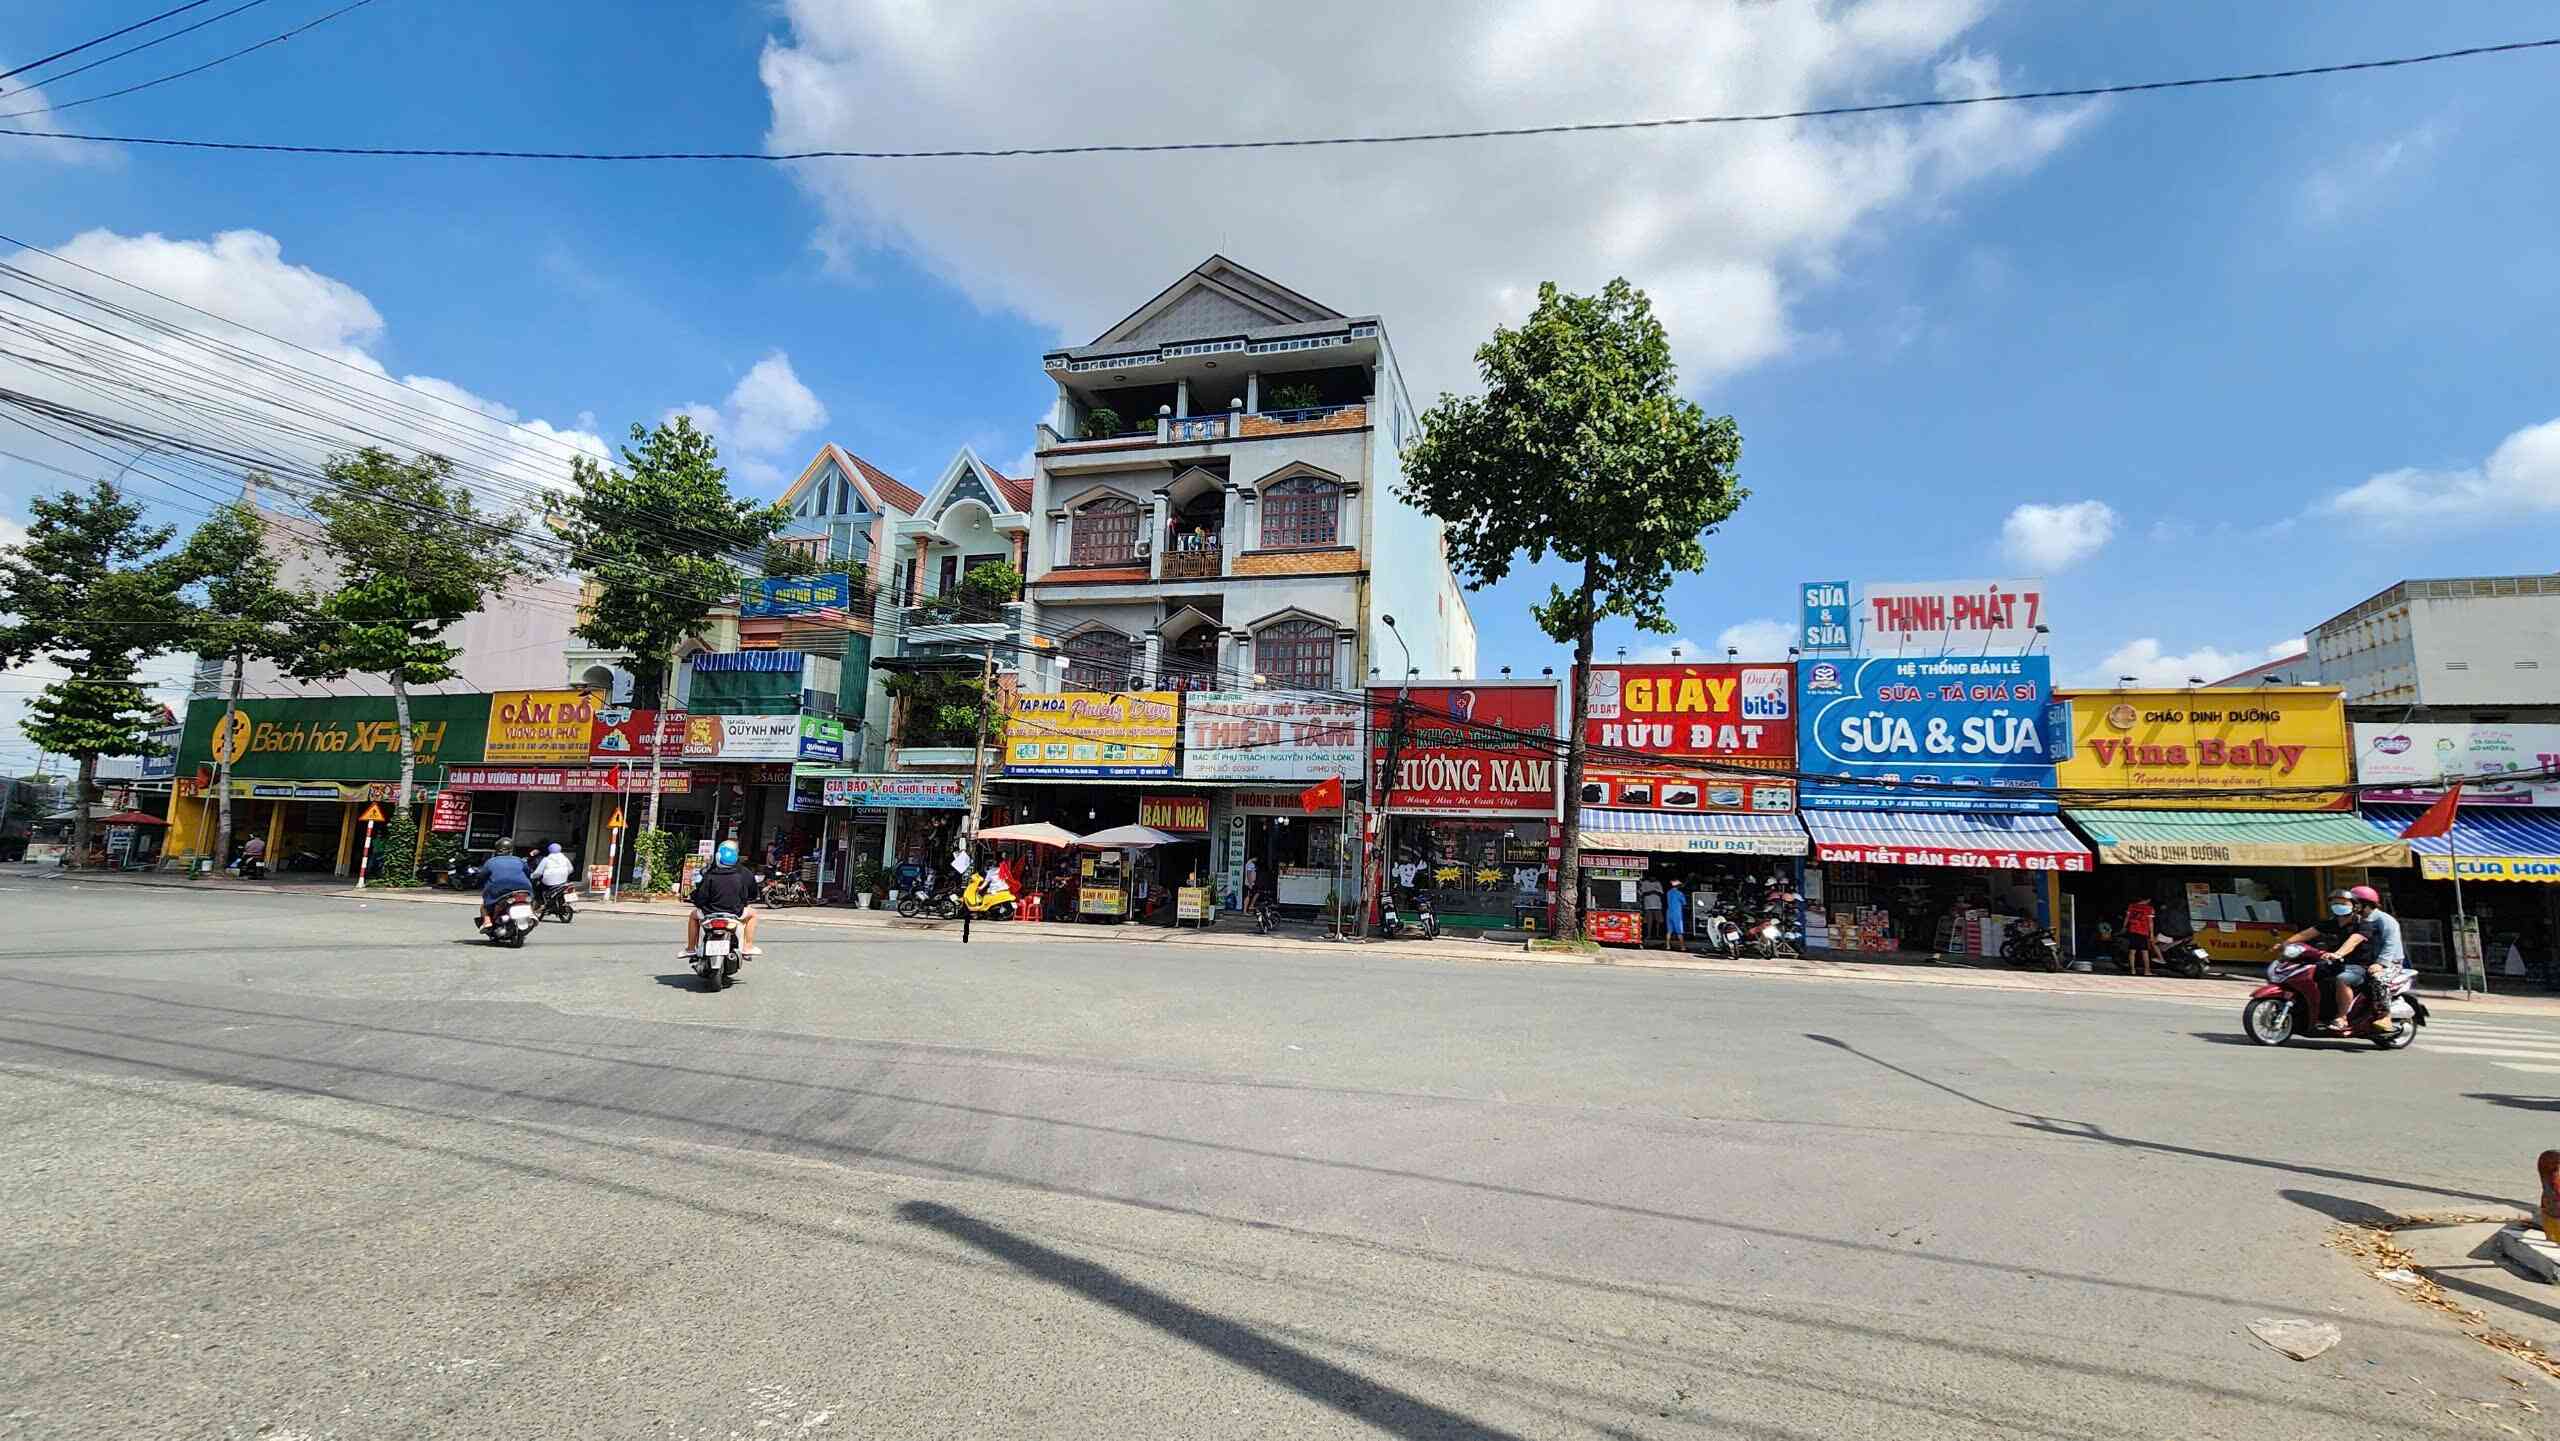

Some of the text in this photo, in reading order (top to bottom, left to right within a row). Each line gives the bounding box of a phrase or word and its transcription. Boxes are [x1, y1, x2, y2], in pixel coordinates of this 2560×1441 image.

[1807, 585, 1845, 607] SỮA
[1820, 609, 1833, 621] &
[1872, 584, 2040, 642] THỊNH PHÁT 7
[1807, 623, 1847, 645] SỮA
[1897, 662, 1917, 677] HỆ
[1921, 658, 1968, 675] THỐNG
[1970, 661, 2001, 675] BÁN
[1625, 668, 1737, 713] GIÀY
[1879, 681, 1920, 702] SỮA
[1940, 681, 1967, 701] TÃ
[1970, 680, 2008, 701] GIÁ
[501, 693, 592, 724] CẦM ĐỒ
[2145, 707, 2281, 723] CHÁO DINH DƯỠNG
[251, 720, 303, 752] Bách
[307, 720, 348, 752] hóa
[728, 722, 796, 735] QUỲNH NHƯ
[1602, 718, 1764, 754] HỮU ĐẠT
[1840, 709, 2043, 754] SỮA & SỮA
[684, 745, 713, 754] SAIGON
[2089, 737, 2306, 774] Vina Baby
[1489, 759, 1552, 793] NAM
[1273, 792, 1301, 809] KHÁ
[1143, 800, 1171, 826] BÁN
[1688, 838, 1719, 850] HỮU
[2129, 843, 2230, 862] CHÁO DINH DƯỠNG
[1820, 848, 1861, 862] CAM
[1865, 846, 1899, 864] KẾT
[1905, 850, 1944, 866] BÁN
[1948, 851, 1991, 867] SỮA
[1996, 852, 2023, 869] TÃ
[2025, 853, 2060, 870] GIÁ
